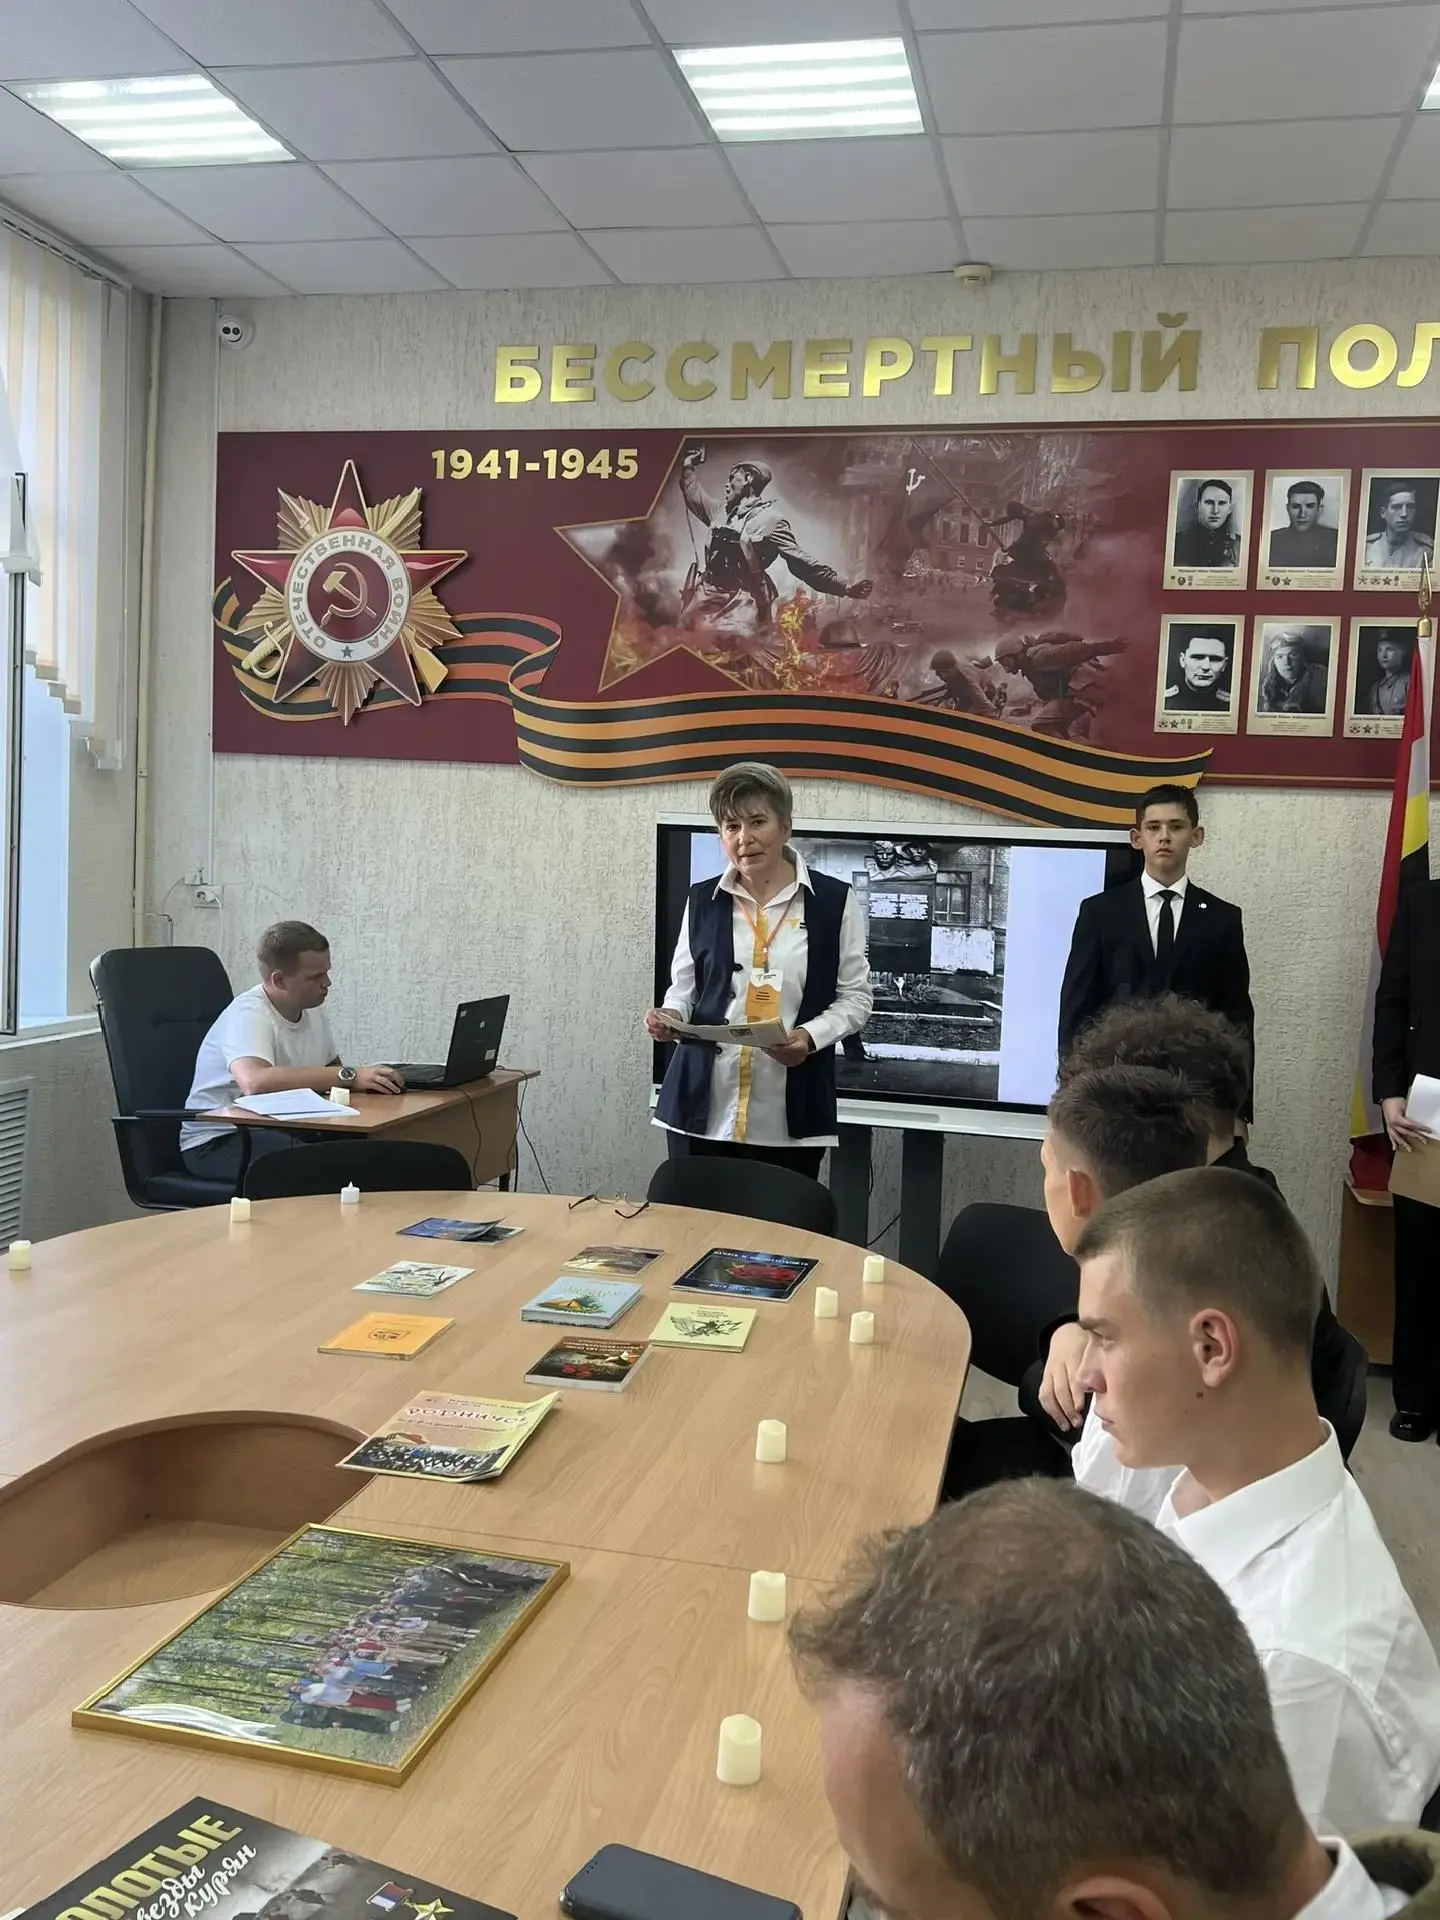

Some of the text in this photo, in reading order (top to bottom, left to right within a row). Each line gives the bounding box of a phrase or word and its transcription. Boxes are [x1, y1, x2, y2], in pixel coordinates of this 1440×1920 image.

[493, 312, 1200, 402] БЕССМЕРТНЫЙ
[432, 448, 639, 480] 1941-1945
[292, 535, 404, 649] ОТЕЧЕСТВЕННАЯ ВОЙНА
